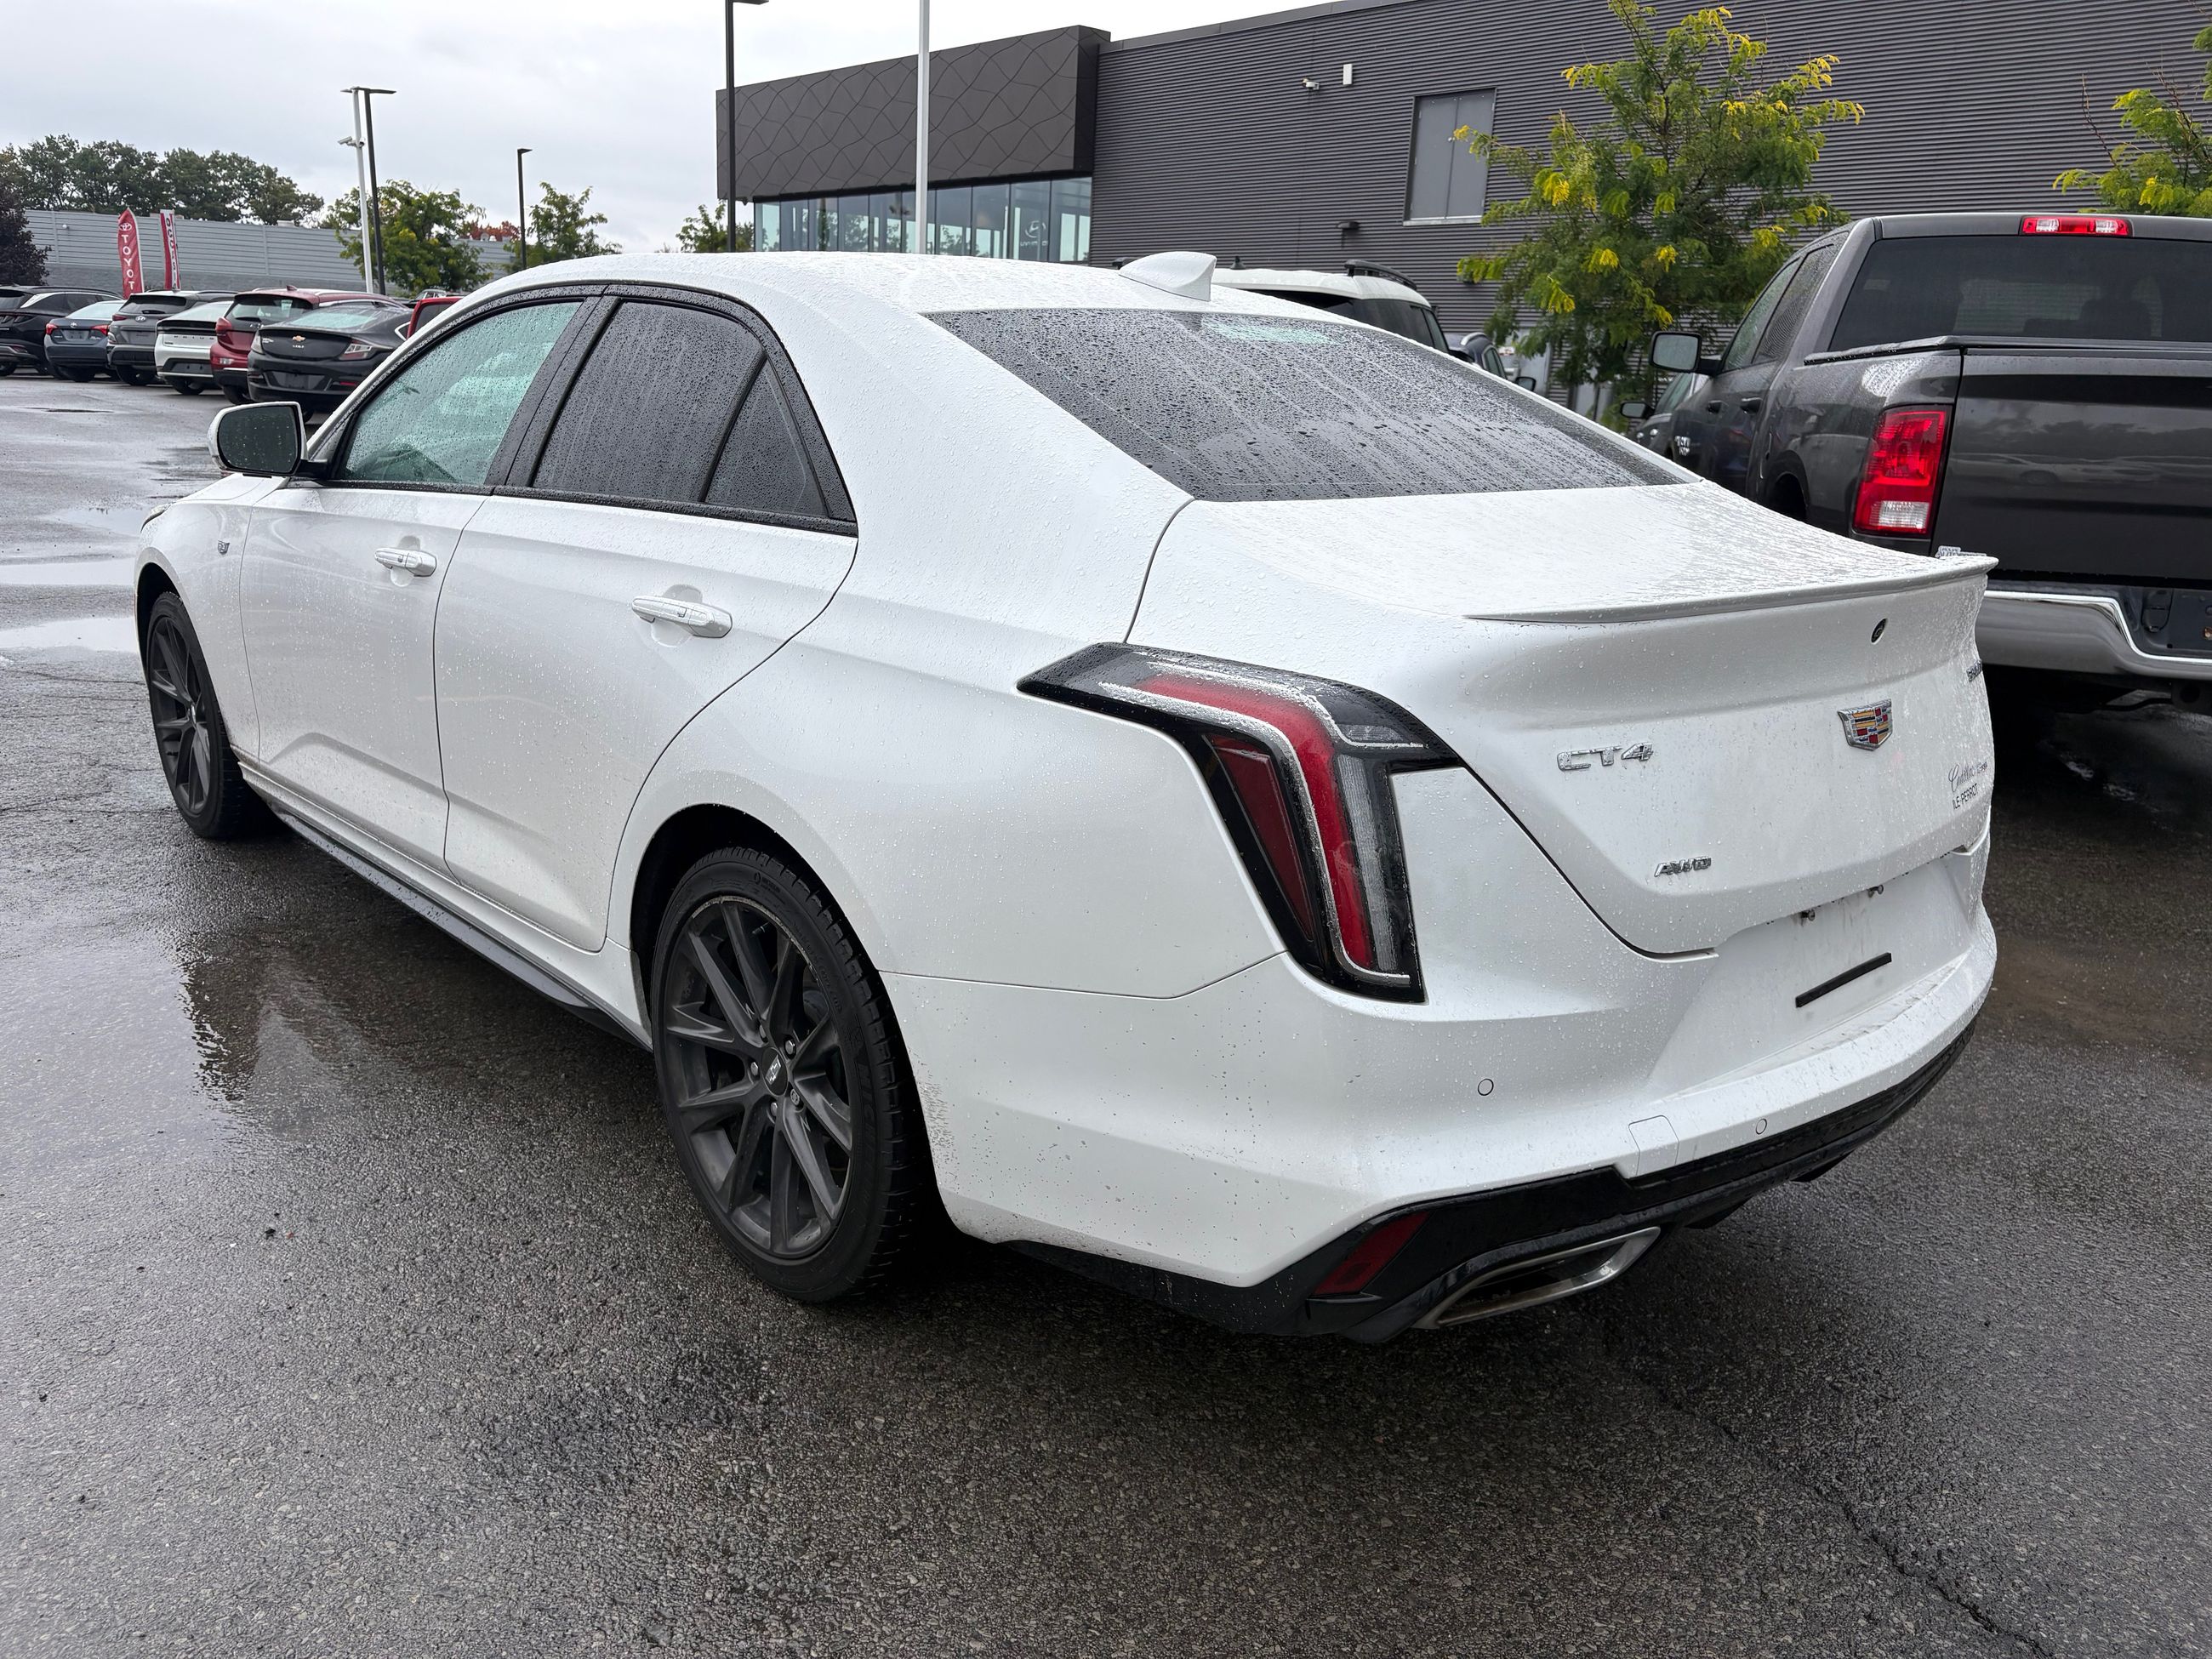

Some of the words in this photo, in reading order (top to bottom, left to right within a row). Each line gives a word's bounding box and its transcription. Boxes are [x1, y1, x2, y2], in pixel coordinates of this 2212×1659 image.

[121, 234, 135, 290] TOYOT
[1557, 741, 1654, 772] CT4
[1654, 855, 1713, 877] AWD
